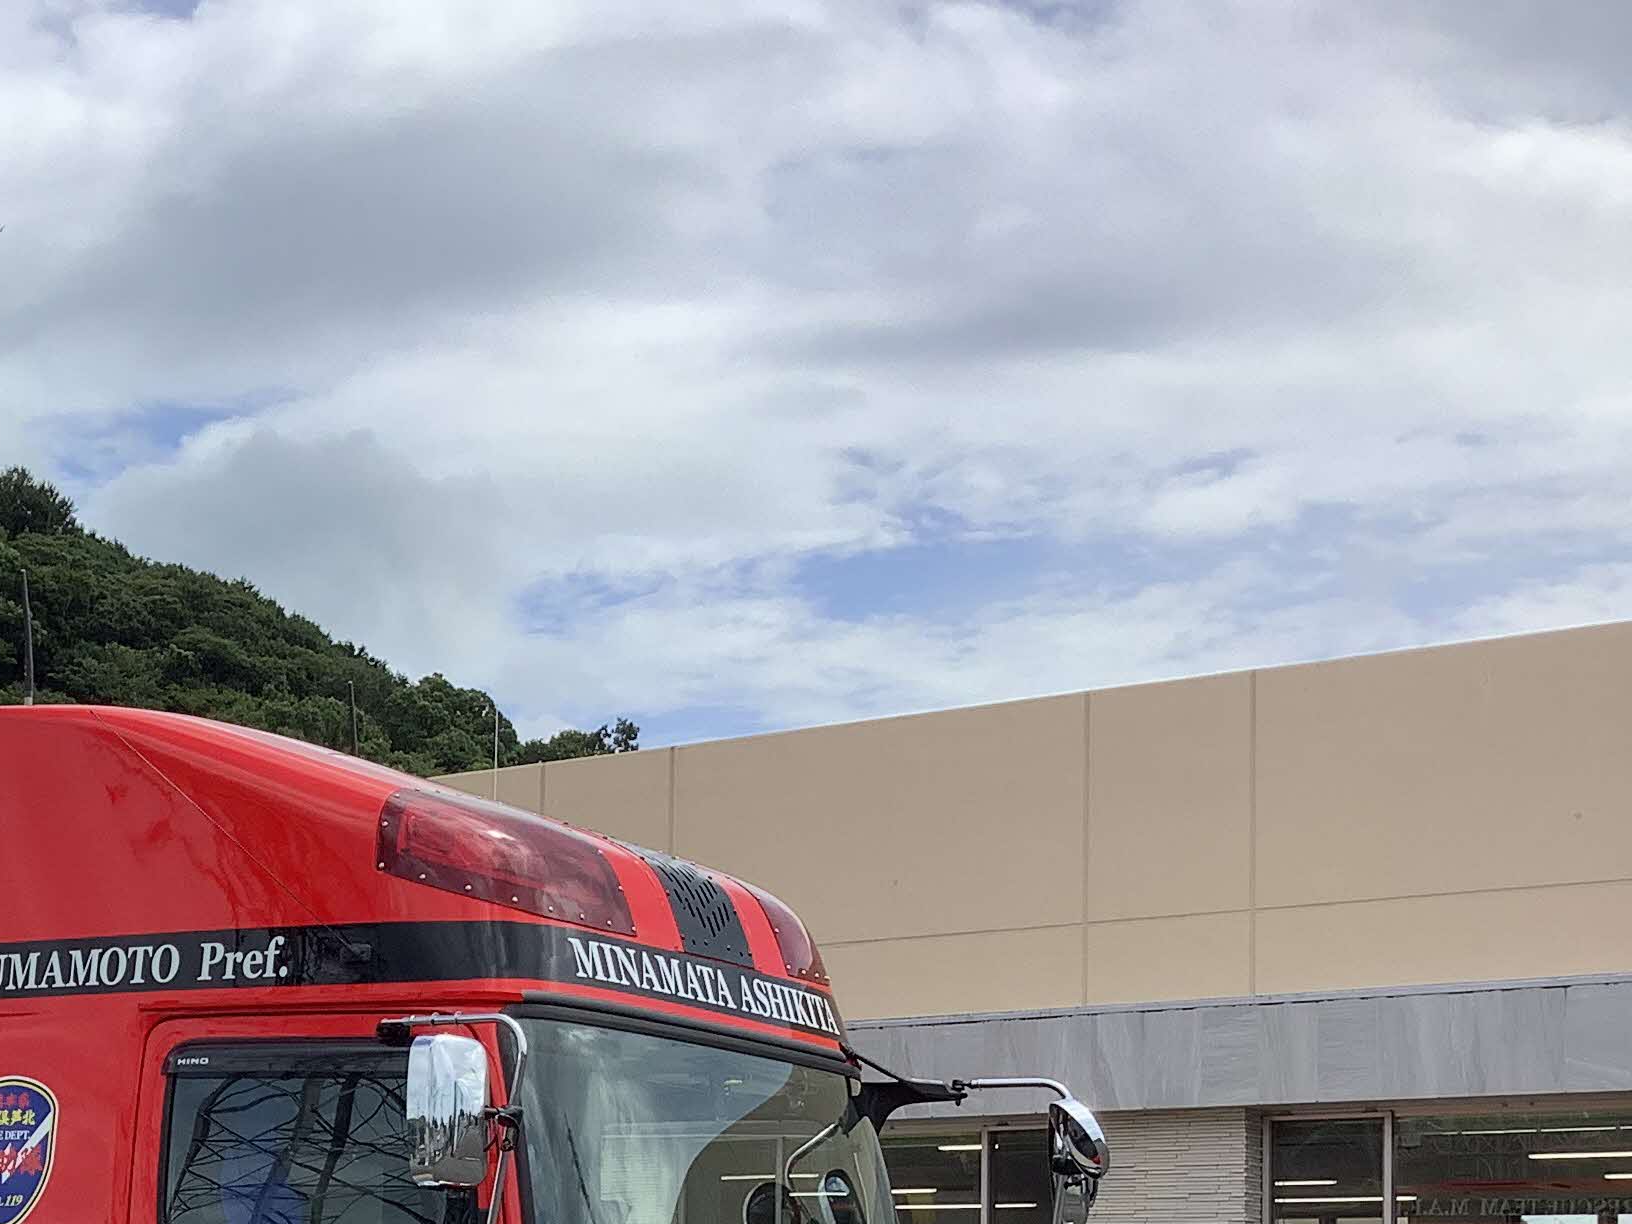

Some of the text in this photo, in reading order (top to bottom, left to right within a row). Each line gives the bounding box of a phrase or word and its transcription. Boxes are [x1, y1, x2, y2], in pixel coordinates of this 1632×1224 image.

[197, 936, 288, 981] Pref.
[568, 937, 840, 1035] MINAMATA ASHIKITA
[177, 1057, 209, 1065] HINO
[4, 1130, 31, 1140] DEPT.
[4, 1195, 23, 1206] 119
